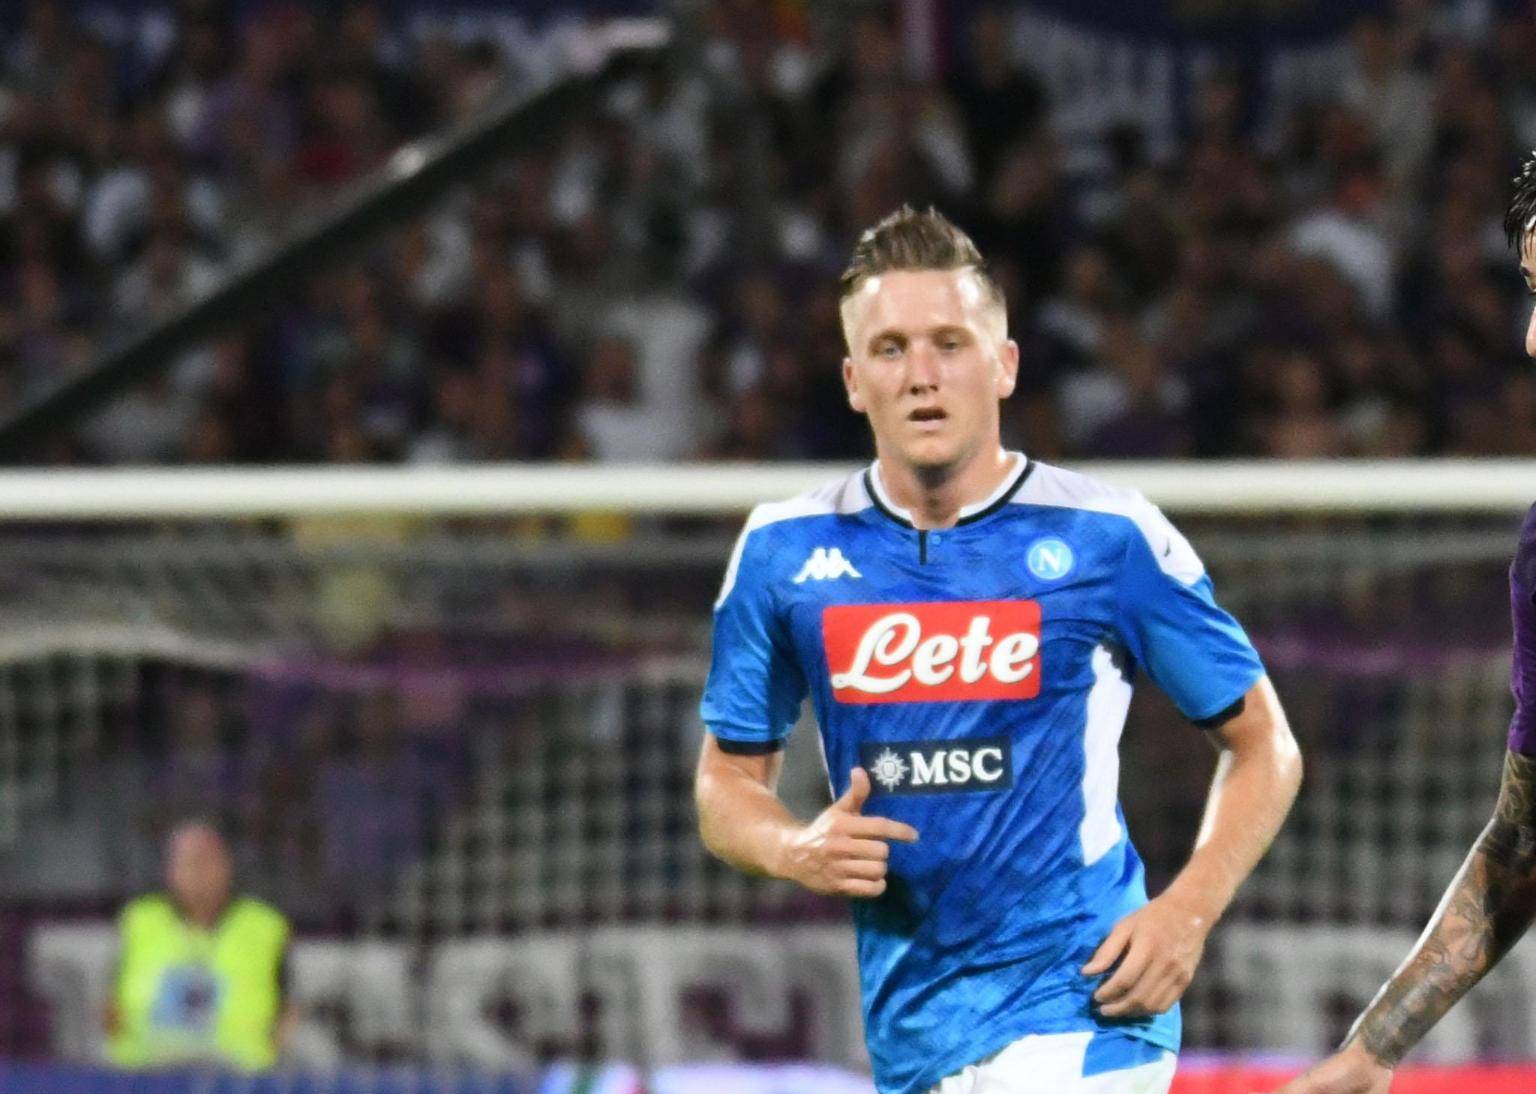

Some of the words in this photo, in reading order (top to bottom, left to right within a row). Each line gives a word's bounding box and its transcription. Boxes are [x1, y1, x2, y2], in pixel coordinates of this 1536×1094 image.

[1037, 547, 1062, 573] N
[831, 611, 1040, 694] Lete
[909, 747, 1004, 785] MSC
